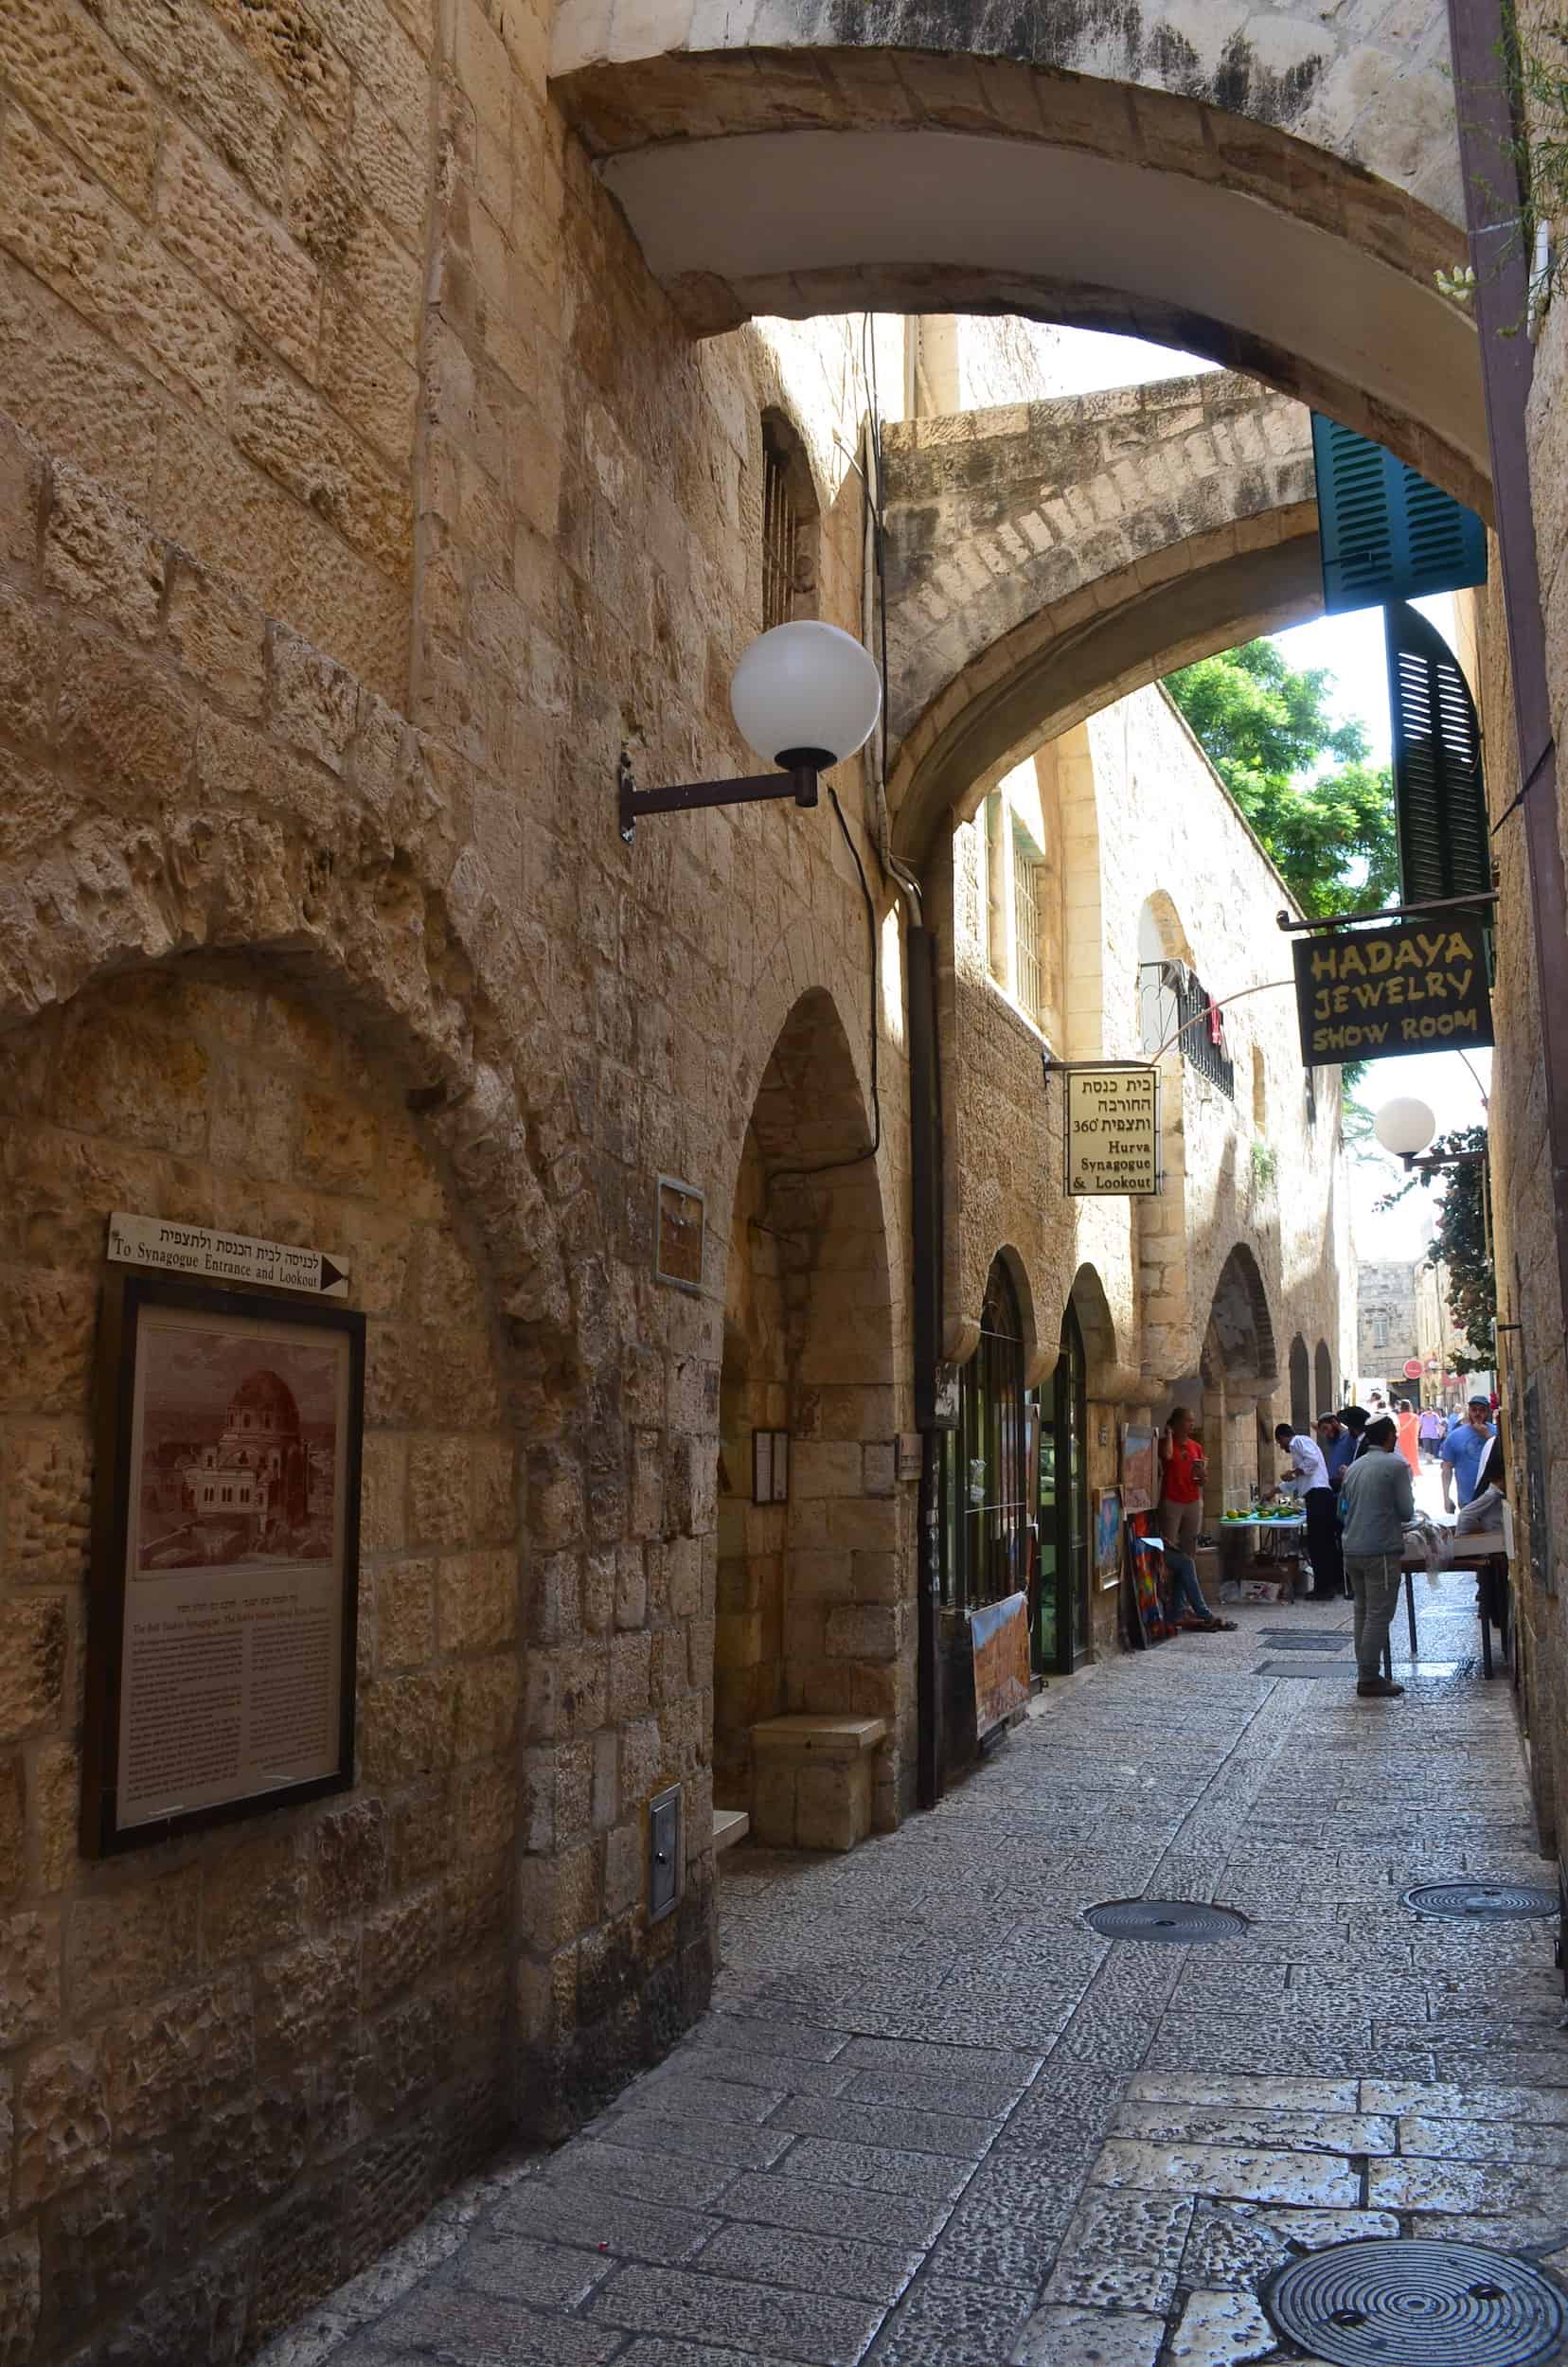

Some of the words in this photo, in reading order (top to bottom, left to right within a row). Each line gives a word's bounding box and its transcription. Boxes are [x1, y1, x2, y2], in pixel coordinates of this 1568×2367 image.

[1310, 932, 1474, 981] HADAYA
[1314, 969, 1472, 1021] JEWELRY
[1312, 1022, 1389, 1052] SHOW
[1401, 1007, 1477, 1041] ROOM
[1082, 1080, 1117, 1093] כנסת
[1126, 1078, 1151, 1092] בית
[1098, 1098, 1150, 1112] החורבה
[1101, 1118, 1150, 1131] ותצפית
[1108, 1141, 1150, 1153] Hurva
[1081, 1158, 1150, 1173] Synagogue
[1074, 1177, 1086, 1189] &
[1096, 1175, 1150, 1189] Lookout
[159, 1228, 212, 1250] ולתצפית
[216, 1238, 251, 1256] הכנסת
[257, 1245, 281, 1261] לבית
[113, 1237, 132, 1256] To
[137, 1242, 199, 1269] Synagogue
[205, 1254, 251, 1277] Entrance
[257, 1265, 274, 1281] and
[280, 1267, 317, 1289] Lookout
[285, 1254, 318, 1269] לכניסה
